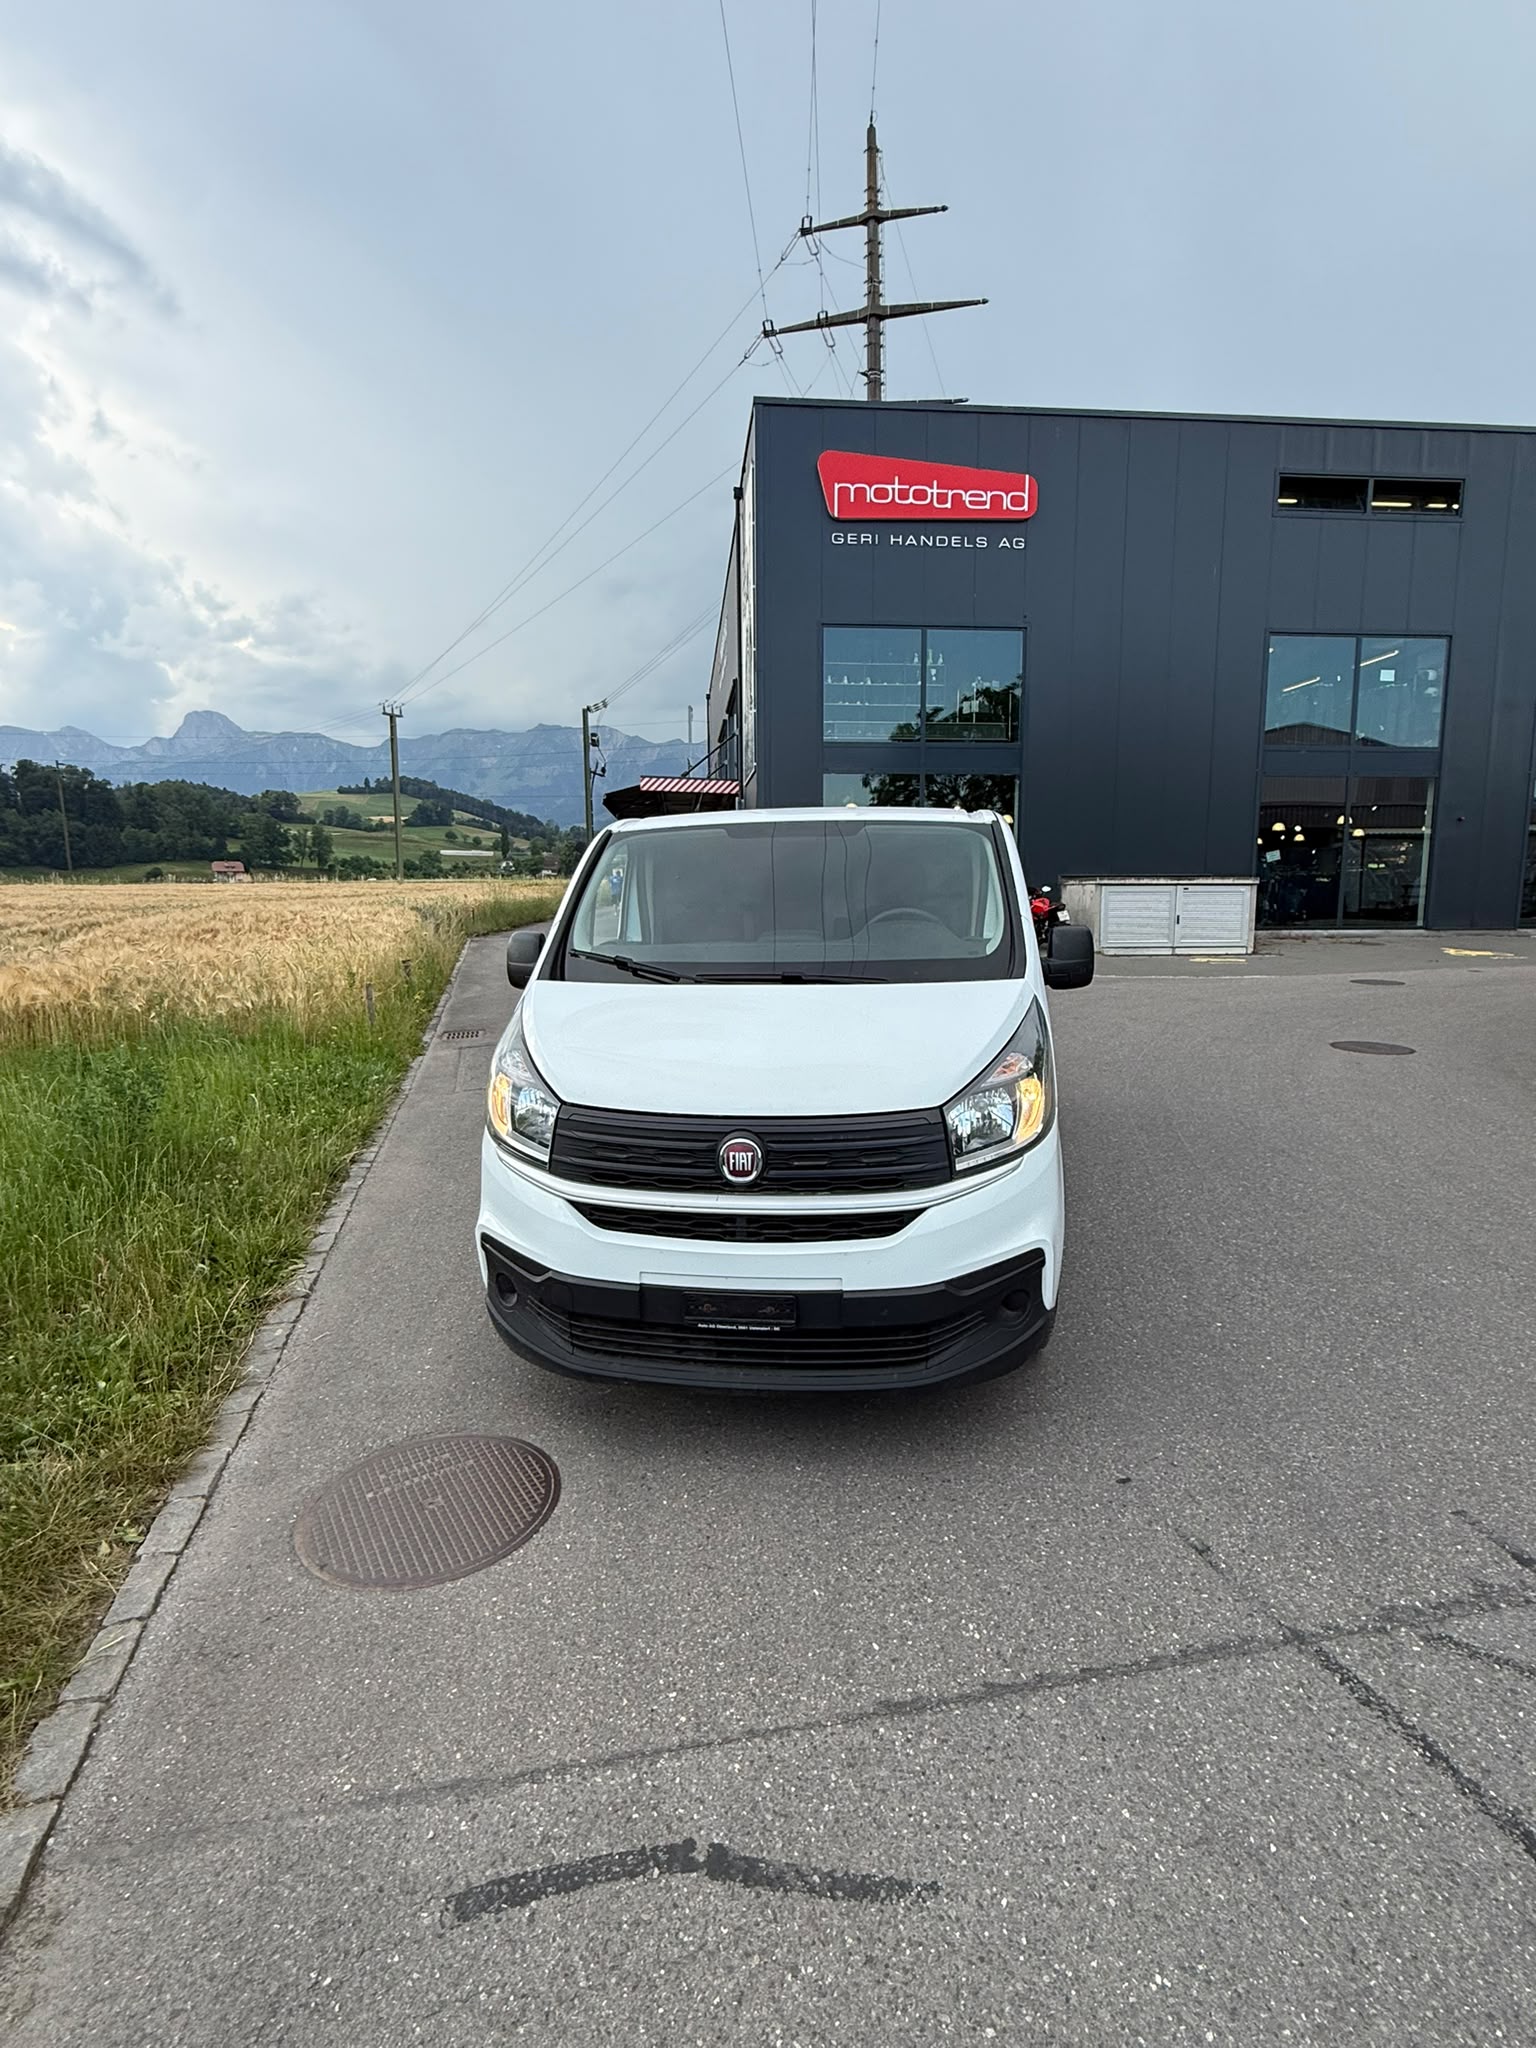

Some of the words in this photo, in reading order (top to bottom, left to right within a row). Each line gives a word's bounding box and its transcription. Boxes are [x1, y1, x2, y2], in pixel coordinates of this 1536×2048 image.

[834, 474, 1029, 517] mototrend
[831, 532, 879, 545] GERI
[890, 534, 988, 548] HANDELS
[998, 537, 1026, 549] AG
[729, 1151, 754, 1171] FIAT
